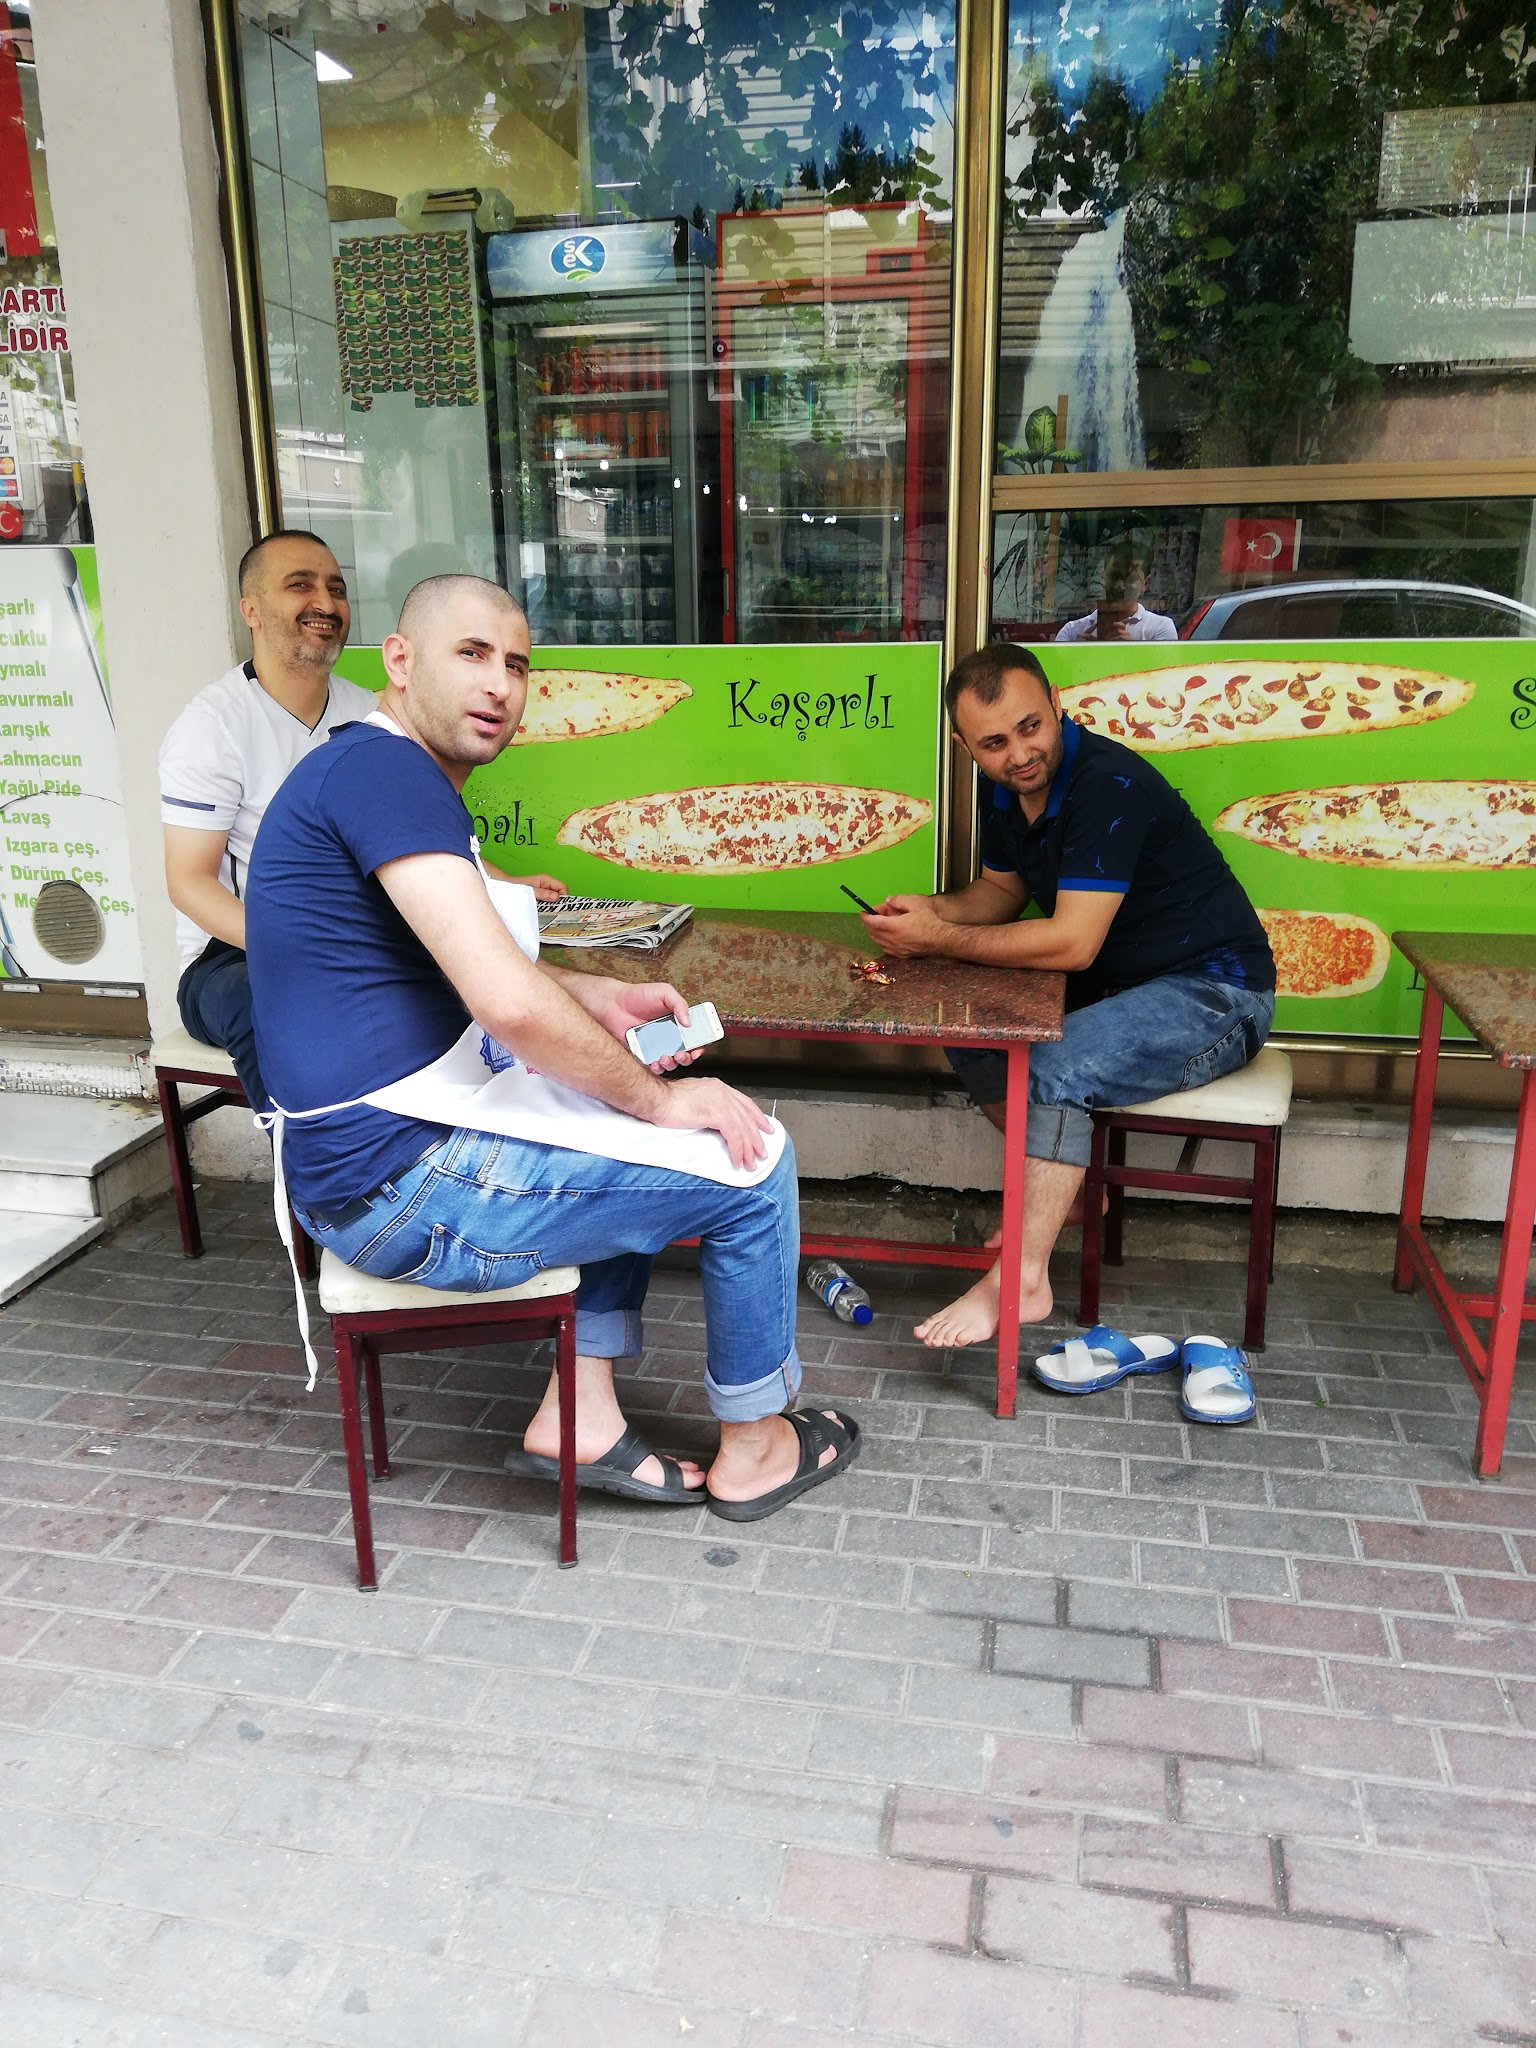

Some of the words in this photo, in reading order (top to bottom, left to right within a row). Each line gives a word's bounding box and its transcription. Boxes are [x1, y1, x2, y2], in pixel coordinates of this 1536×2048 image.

[726, 674, 895, 741] Kaşarlı
[0, 720, 52, 741] arışık
[0, 750, 83, 767] ahmacun
[43, 779, 81, 797] Pide
[0, 809, 51, 829] Lavaş
[5, 836, 59, 857] Izgara
[10, 864, 66, 880] Dürüm
[71, 866, 109, 887] Çeş.
